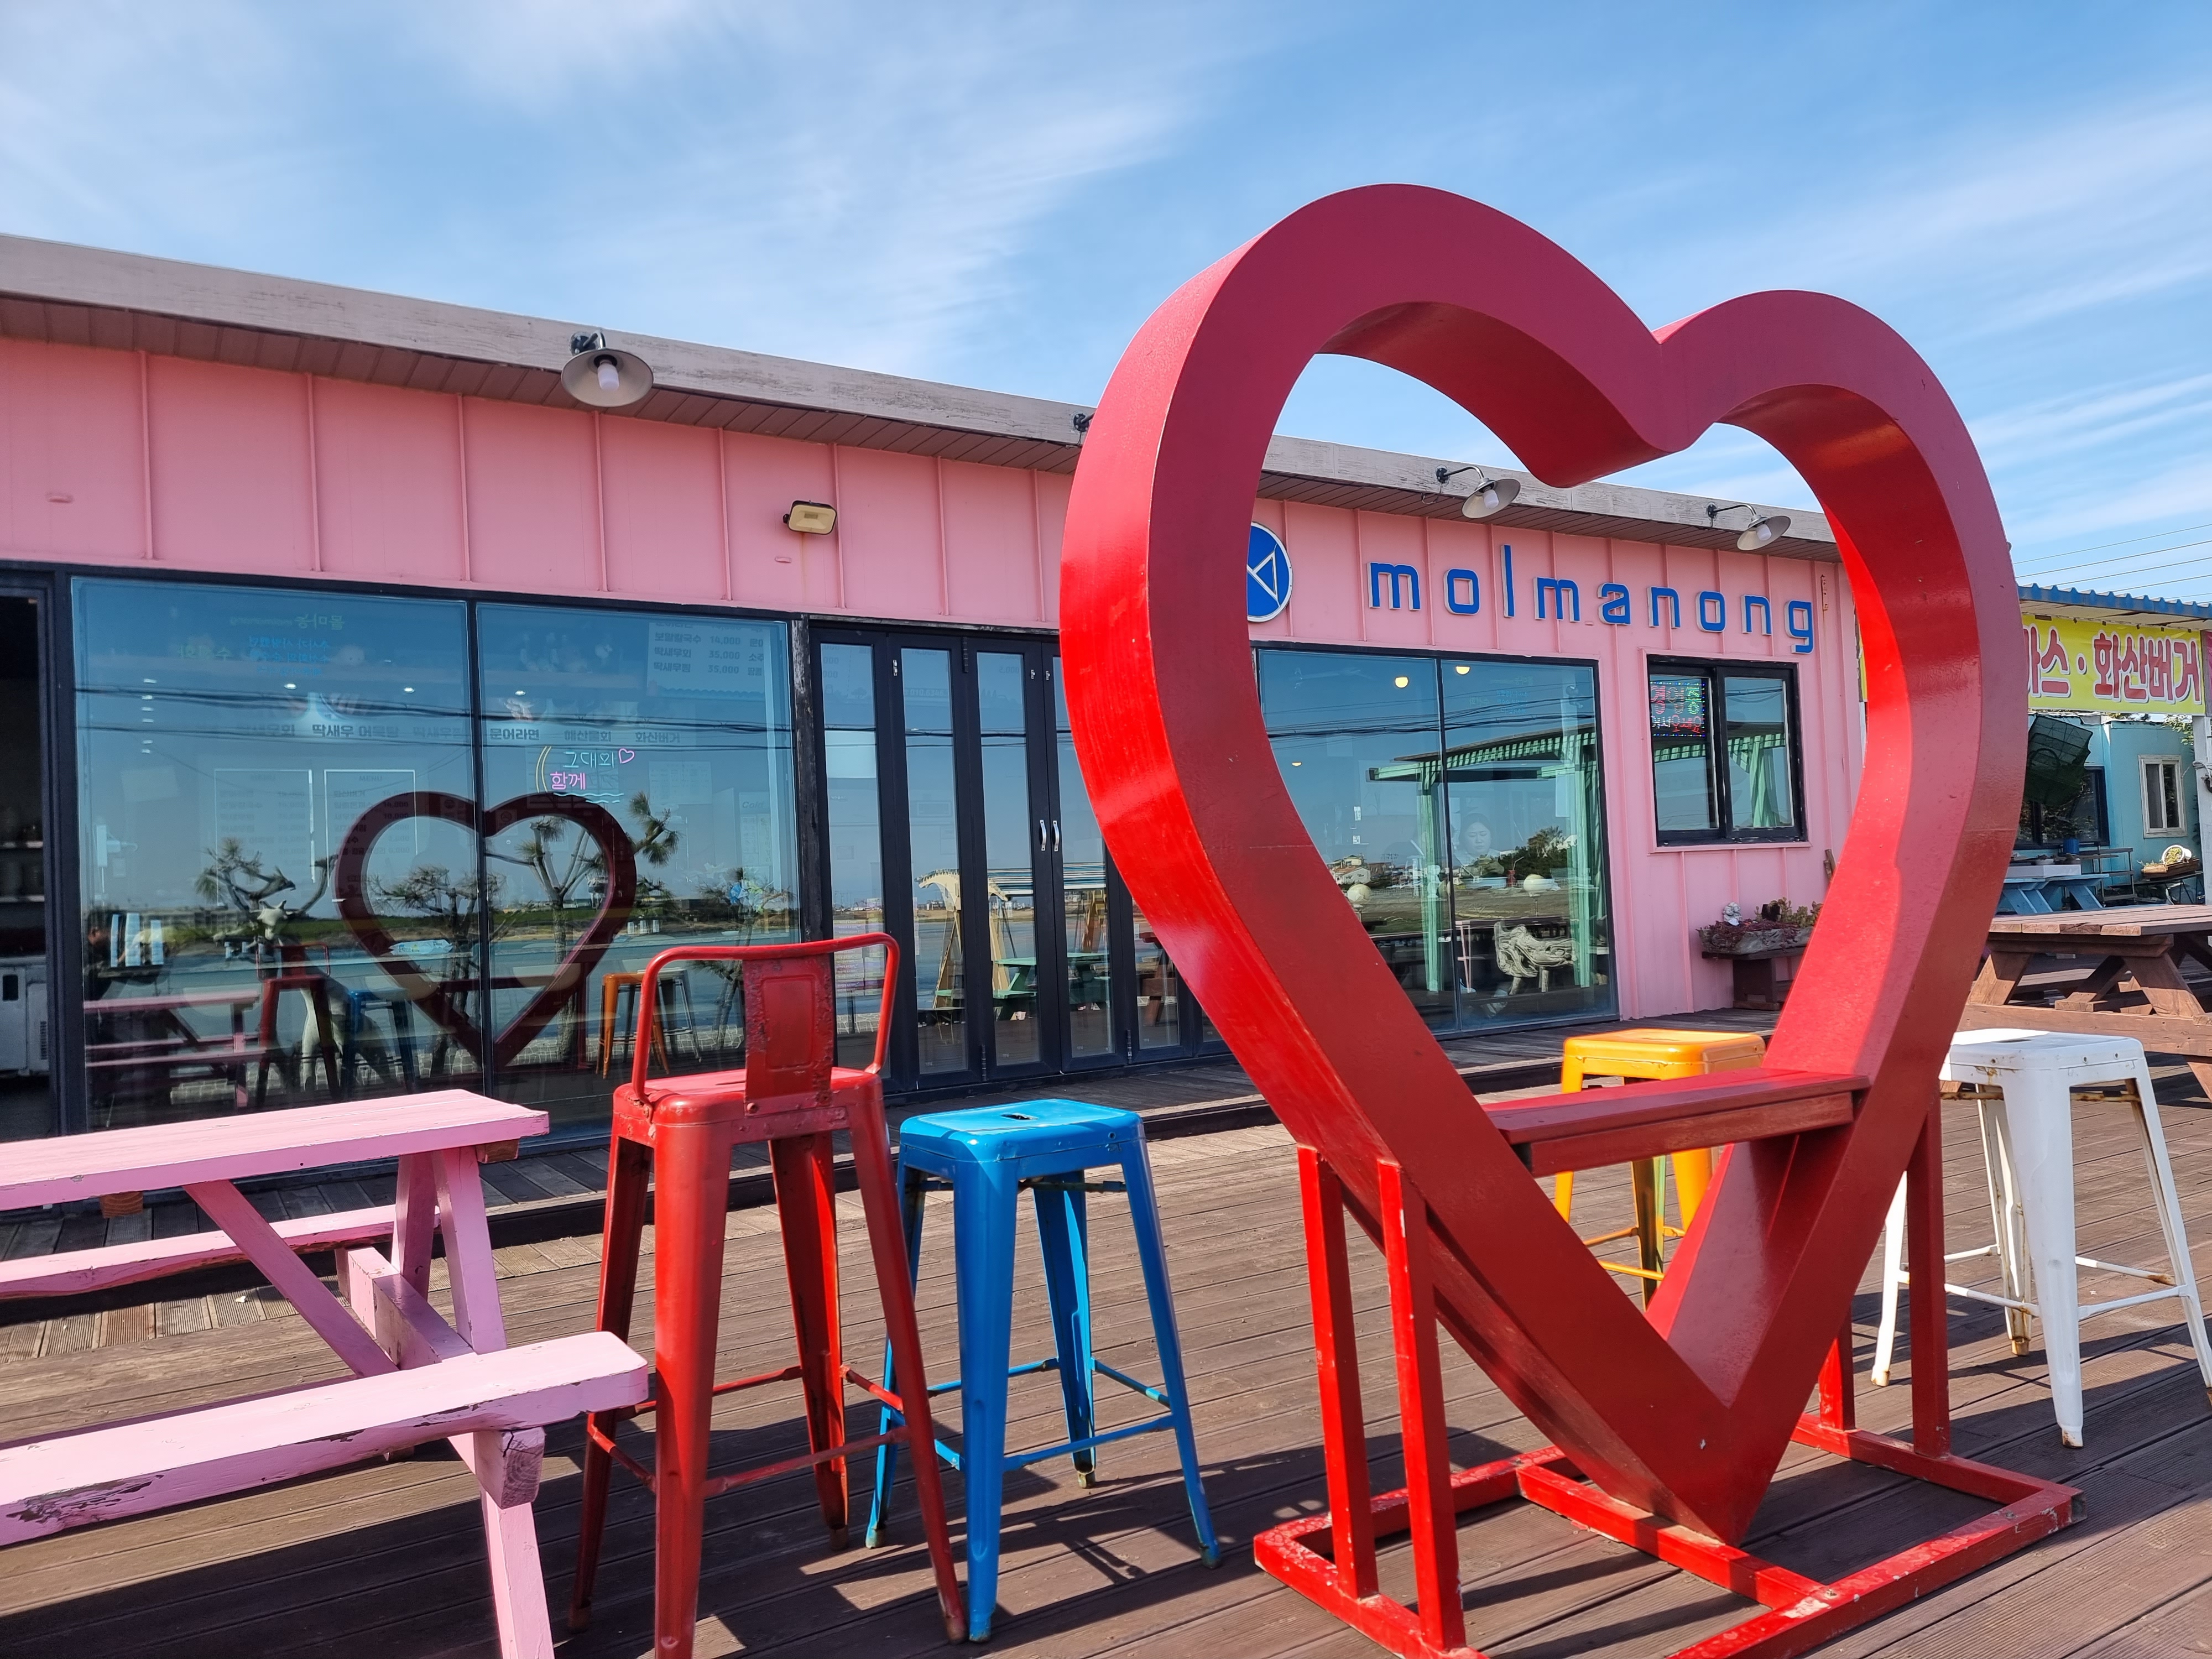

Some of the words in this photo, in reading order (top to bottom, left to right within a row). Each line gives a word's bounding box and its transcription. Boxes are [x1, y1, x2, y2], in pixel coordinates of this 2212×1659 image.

[1368, 544, 1813, 654] molmanong
[710, 636, 740, 645] 14,000
[708, 650, 740, 660] 35,000
[707, 665, 739, 674] 35,000
[2094, 632, 2200, 702] 화산버거
[1650, 686, 1702, 714] 영업중
[312, 724, 354, 737] 딱새우
[489, 728, 540, 741] 문어라면
[635, 732, 681, 744] 화산버거
[563, 751, 615, 769] 그대와
[550, 771, 586, 790] 함께
